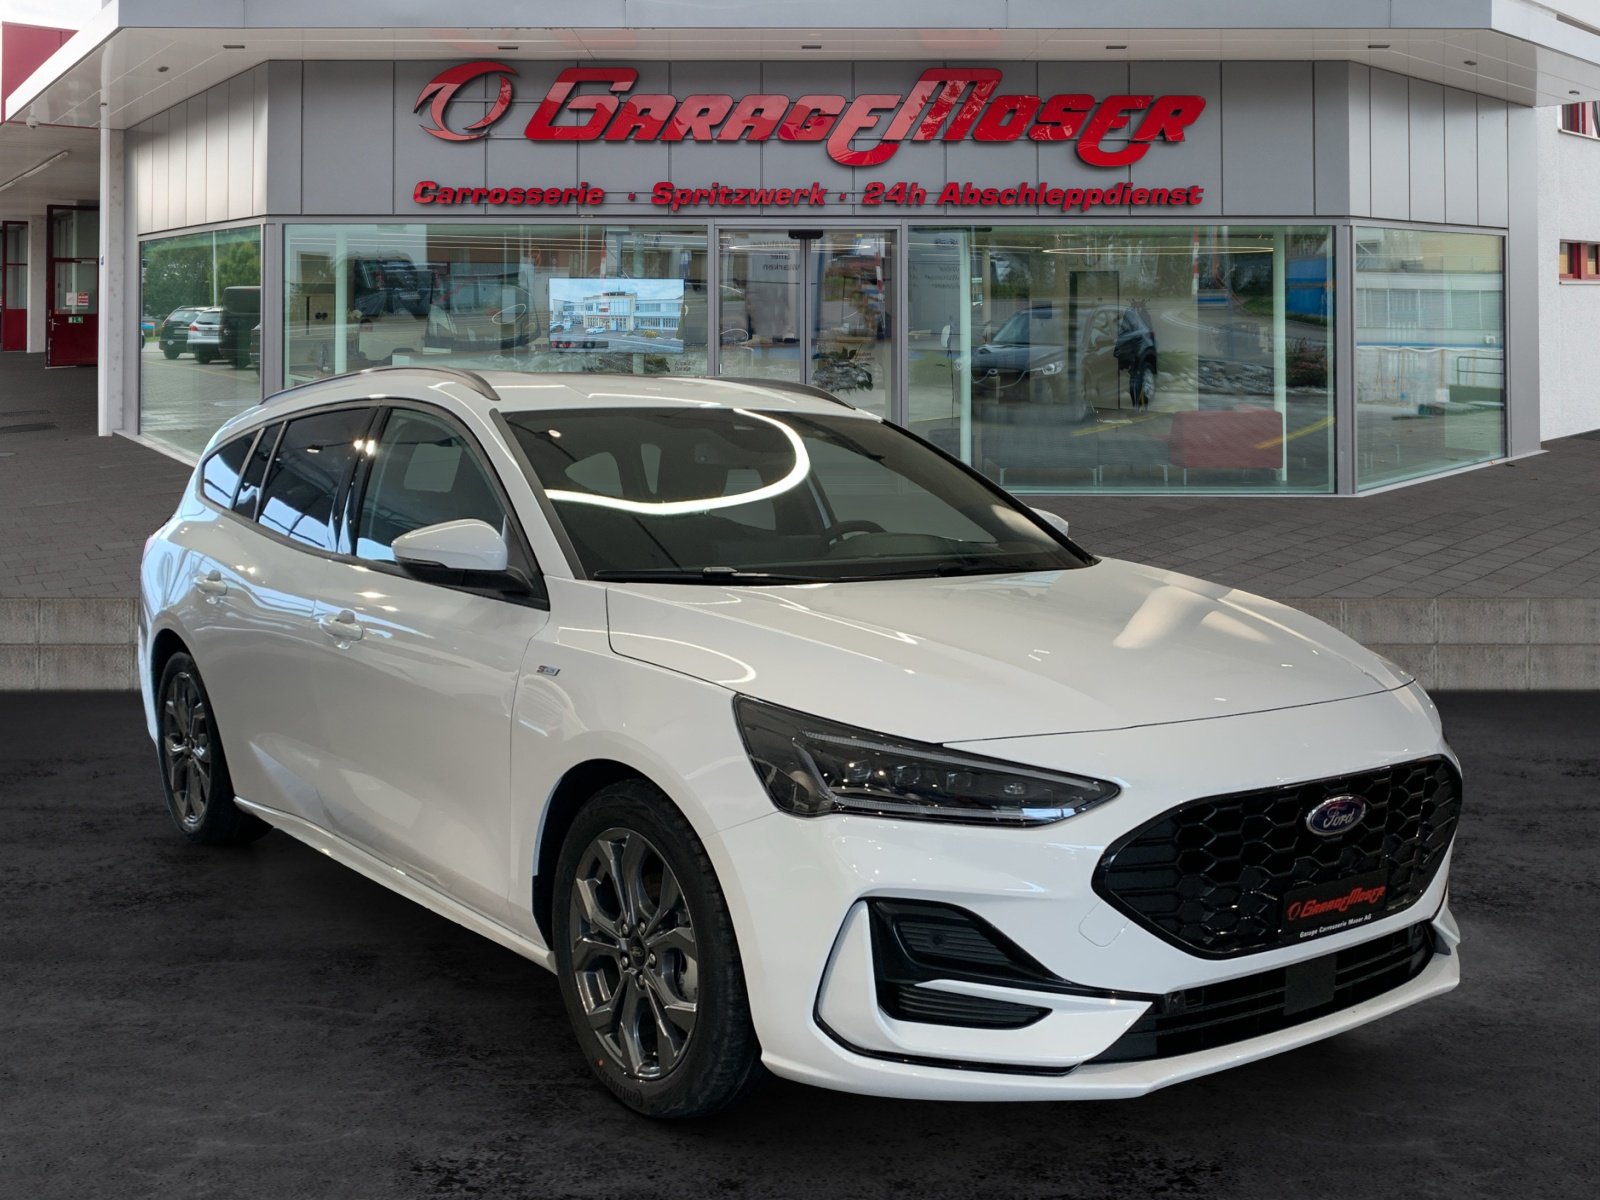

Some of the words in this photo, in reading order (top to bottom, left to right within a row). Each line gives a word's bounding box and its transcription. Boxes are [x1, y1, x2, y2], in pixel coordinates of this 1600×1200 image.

[412, 180, 605, 205] Carrosserie
[650, 181, 827, 211] Spritzwerk
[863, 181, 927, 205] 24h
[937, 182, 1204, 211] Abschleppdienst
[1323, 804, 1355, 828] Ford
